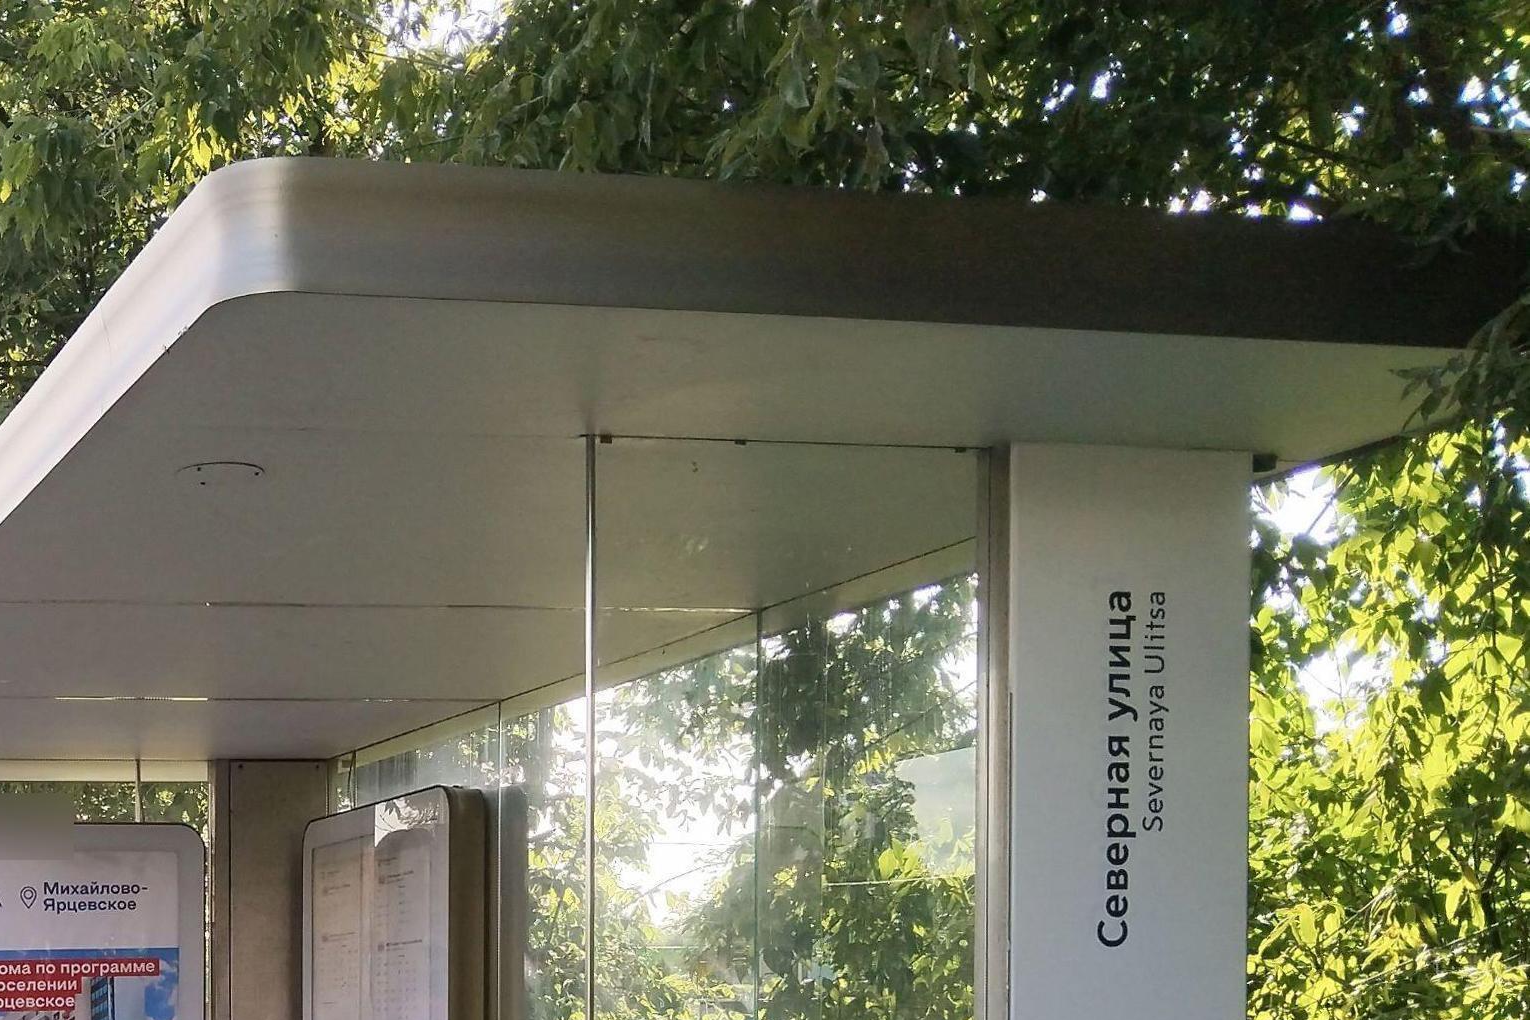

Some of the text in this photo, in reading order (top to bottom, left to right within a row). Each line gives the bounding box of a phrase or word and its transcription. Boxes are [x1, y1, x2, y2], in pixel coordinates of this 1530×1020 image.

[1142, 591, 1170, 832] Severnaya Ulitsa
[1096, 590, 1138, 948] Северная улица
[43, 881, 149, 895] Михайлово-
[43, 898, 137, 914] Ярцевское
[35, 963, 56, 974] по
[60, 961, 156, 976] программе
